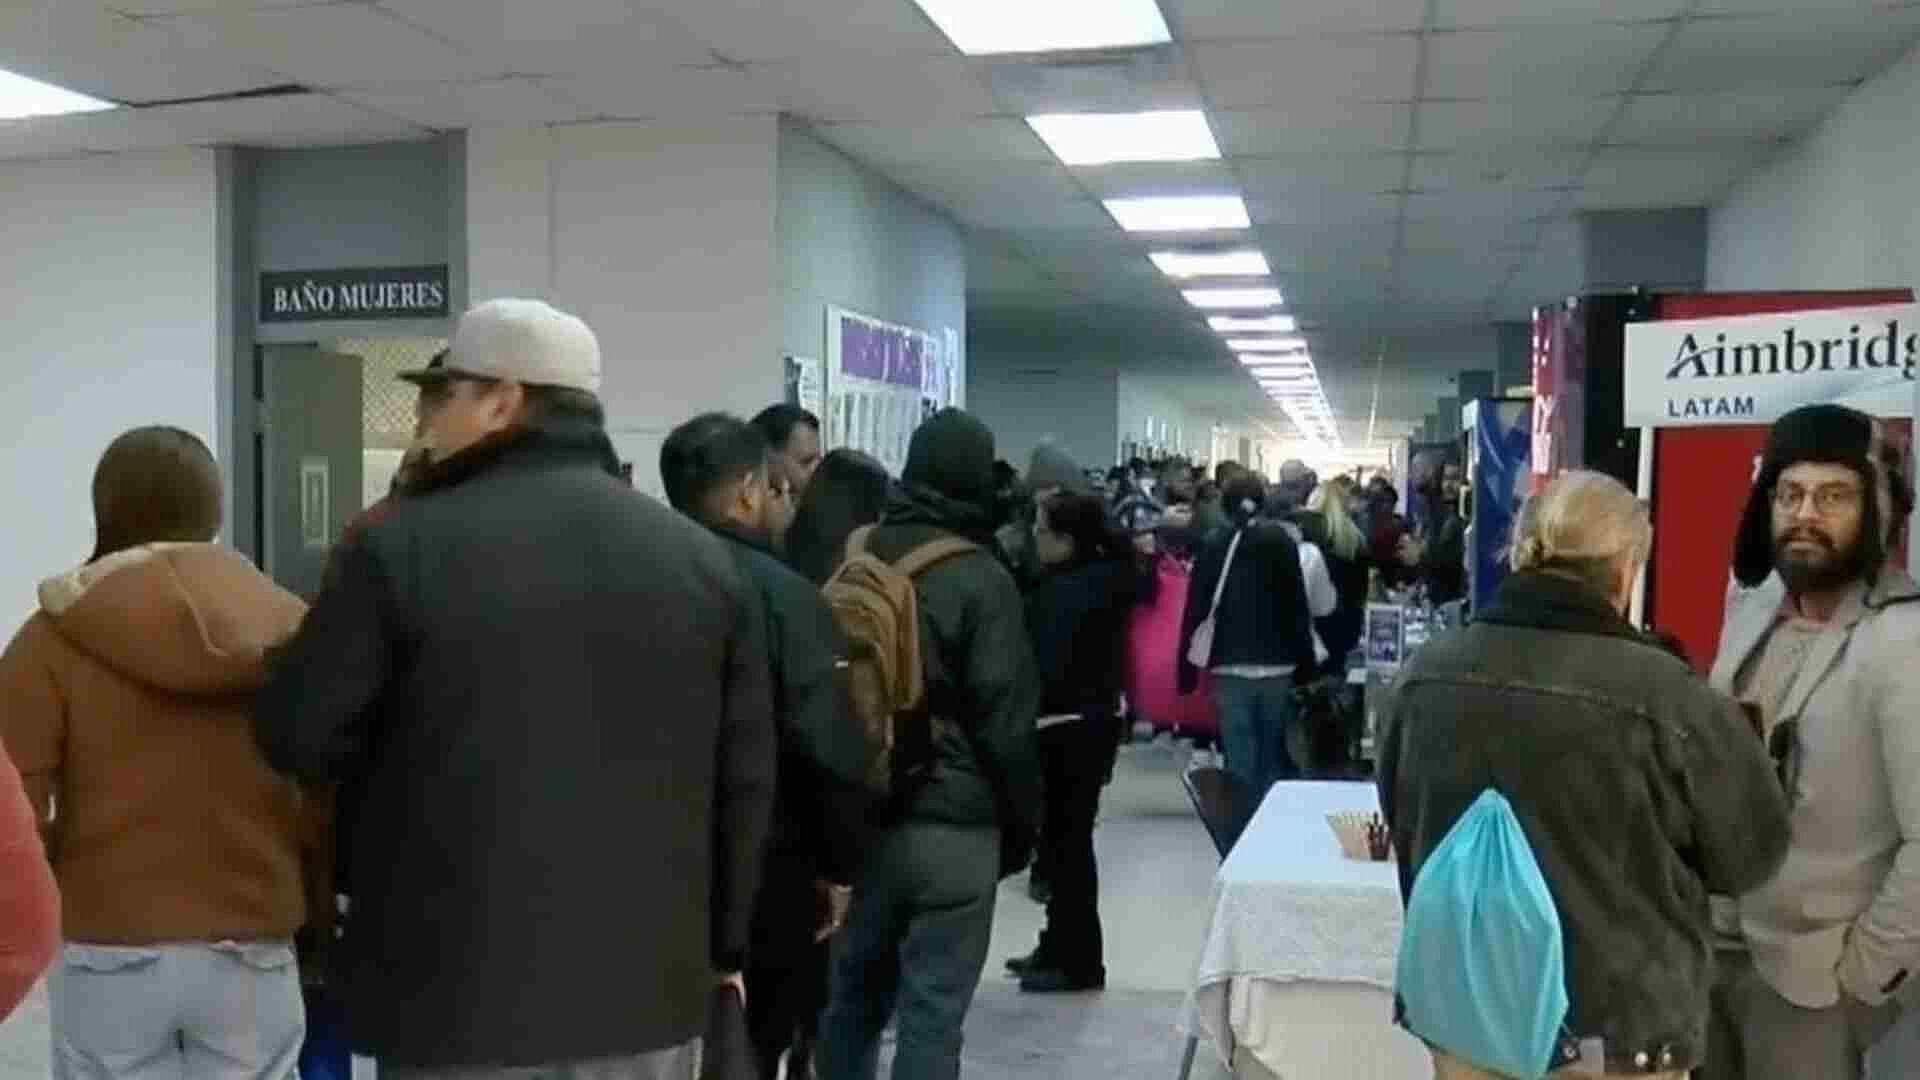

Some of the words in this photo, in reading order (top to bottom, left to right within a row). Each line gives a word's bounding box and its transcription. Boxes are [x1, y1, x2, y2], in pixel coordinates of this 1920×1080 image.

[273, 280, 335, 312] BAÑO
[340, 281, 444, 310] MUJERES
[1668, 396, 1755, 418] LATAM
